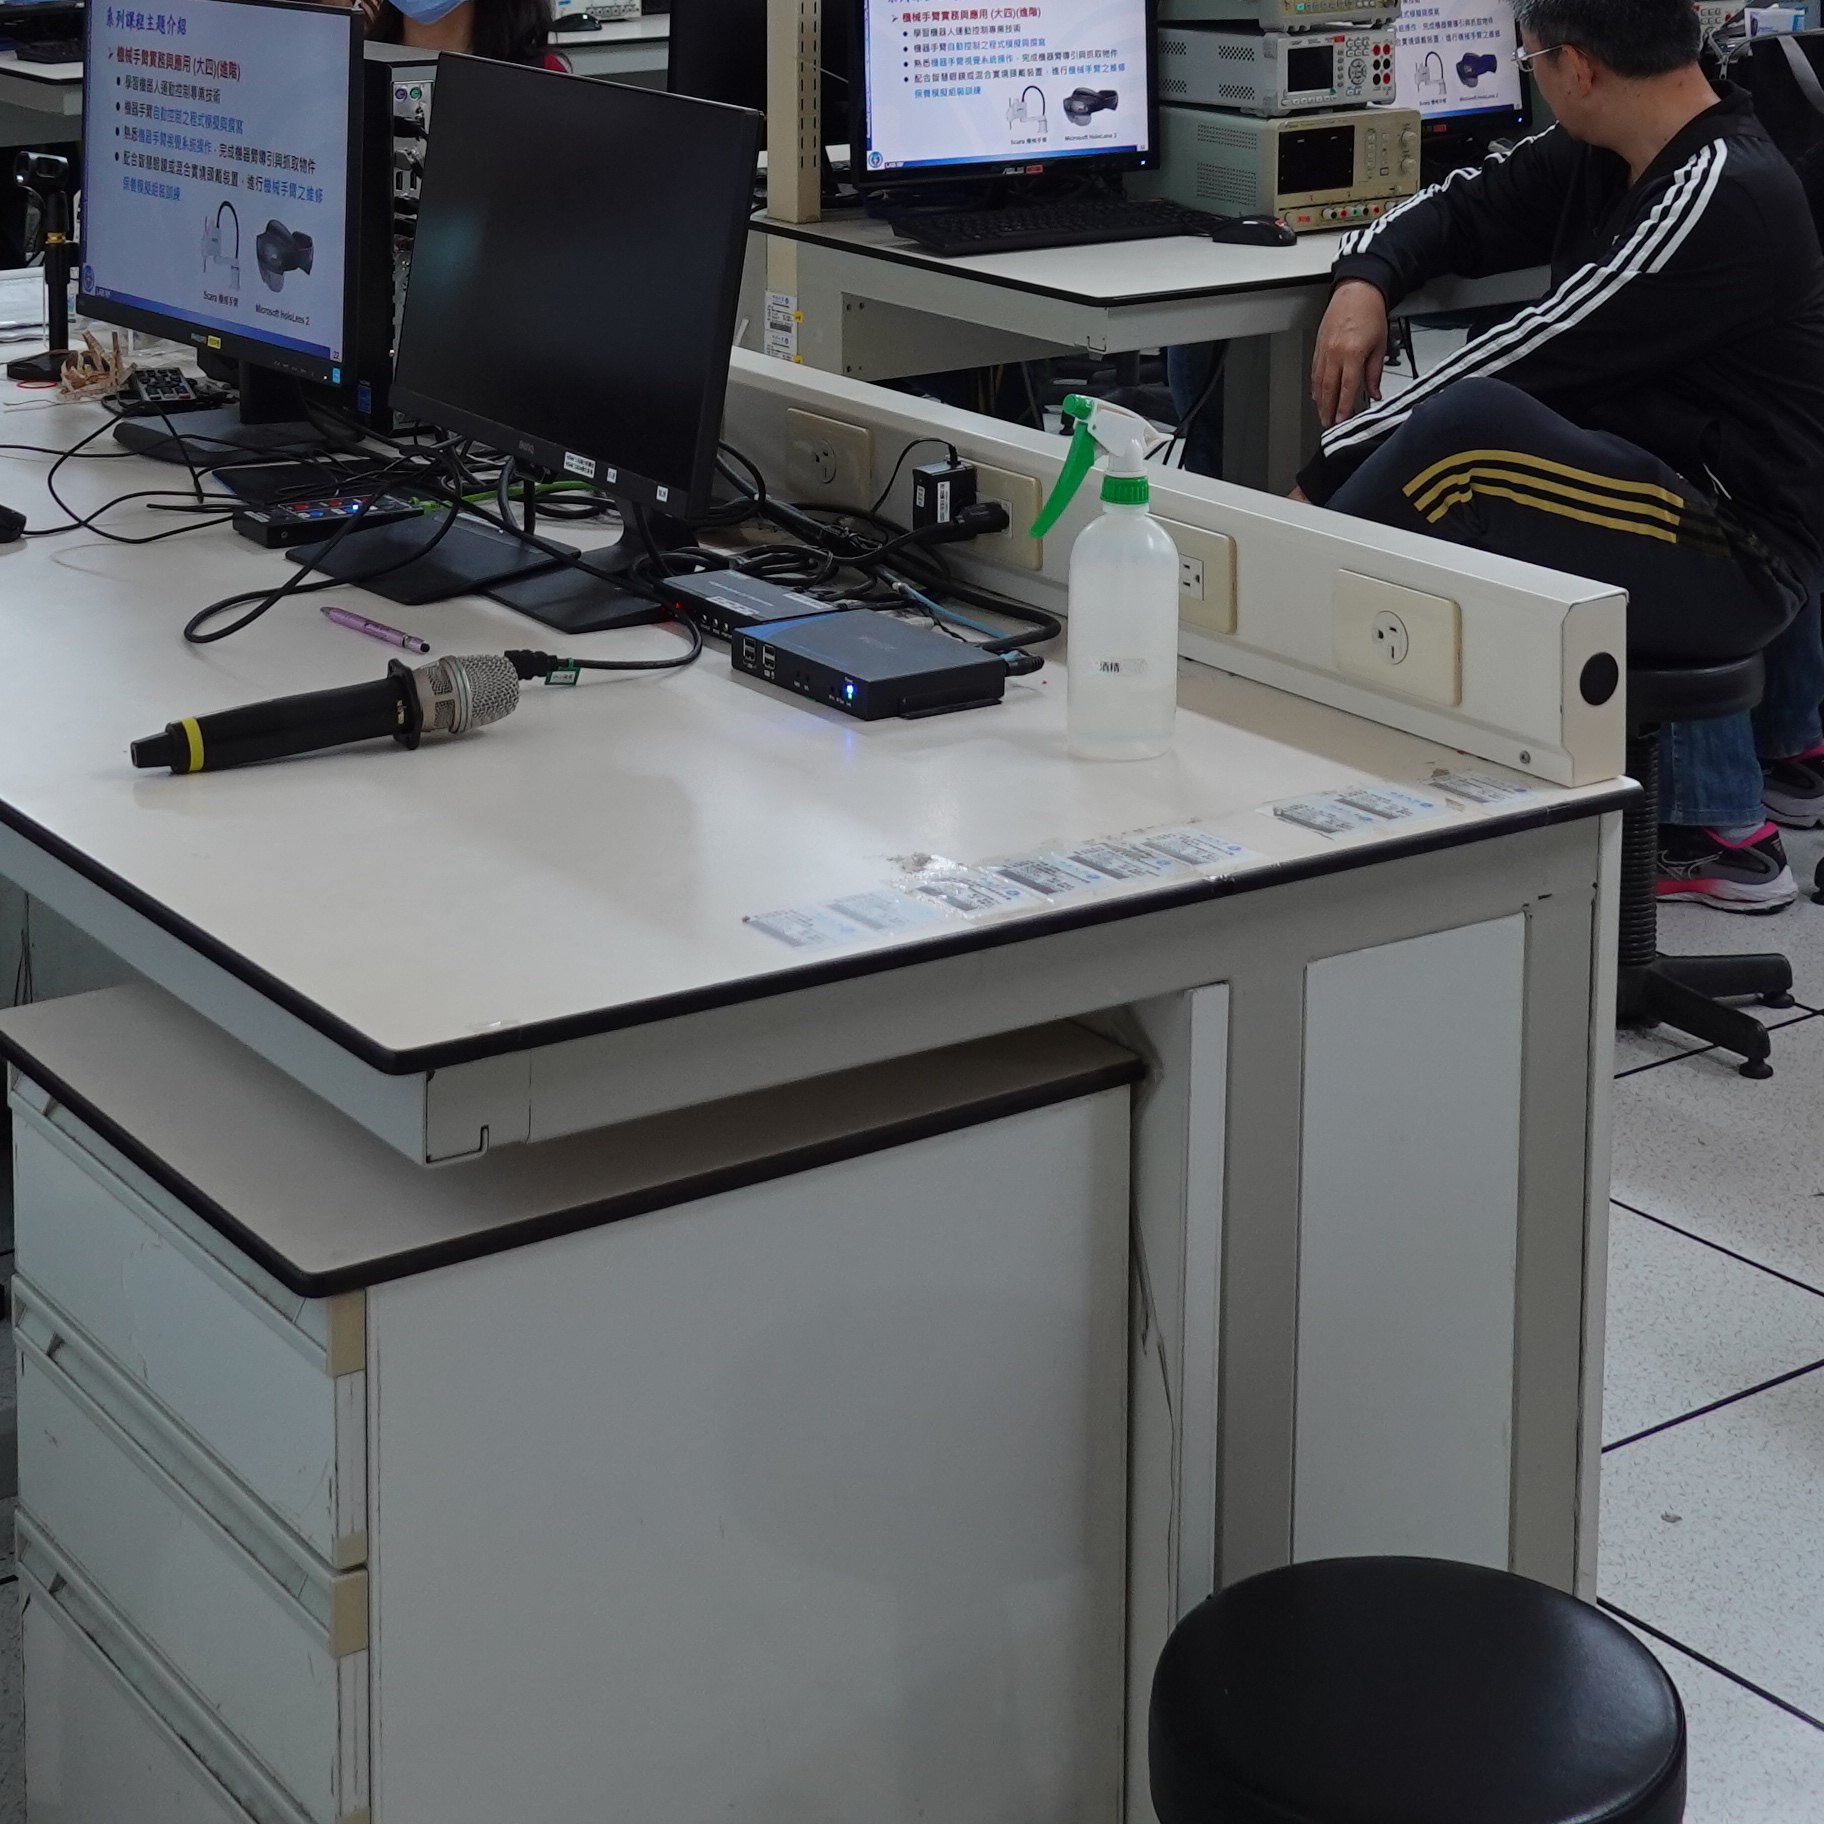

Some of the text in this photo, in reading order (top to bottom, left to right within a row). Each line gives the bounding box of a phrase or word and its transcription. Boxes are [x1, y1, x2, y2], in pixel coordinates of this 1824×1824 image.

[105, 6, 187, 35] 系列課程主題介紹
[902, 6, 1042, 24] 機械手臂實務與應用 (大四)(進階)
[913, 24, 1022, 39] 學習機器人運動控制專業技術
[117, 45, 241, 82] 機械手臂實務與應用 (大四)(進階)
[124, 74, 221, 105] 學習機器人運動控制專業技術
[1002, 166, 1025, 175] ASUS
[203, 290, 217, 303] Scara
[255, 303, 279, 319] Microsoft
[280, 309, 305, 325] HoloLens
[333, 350, 340, 360] 22
